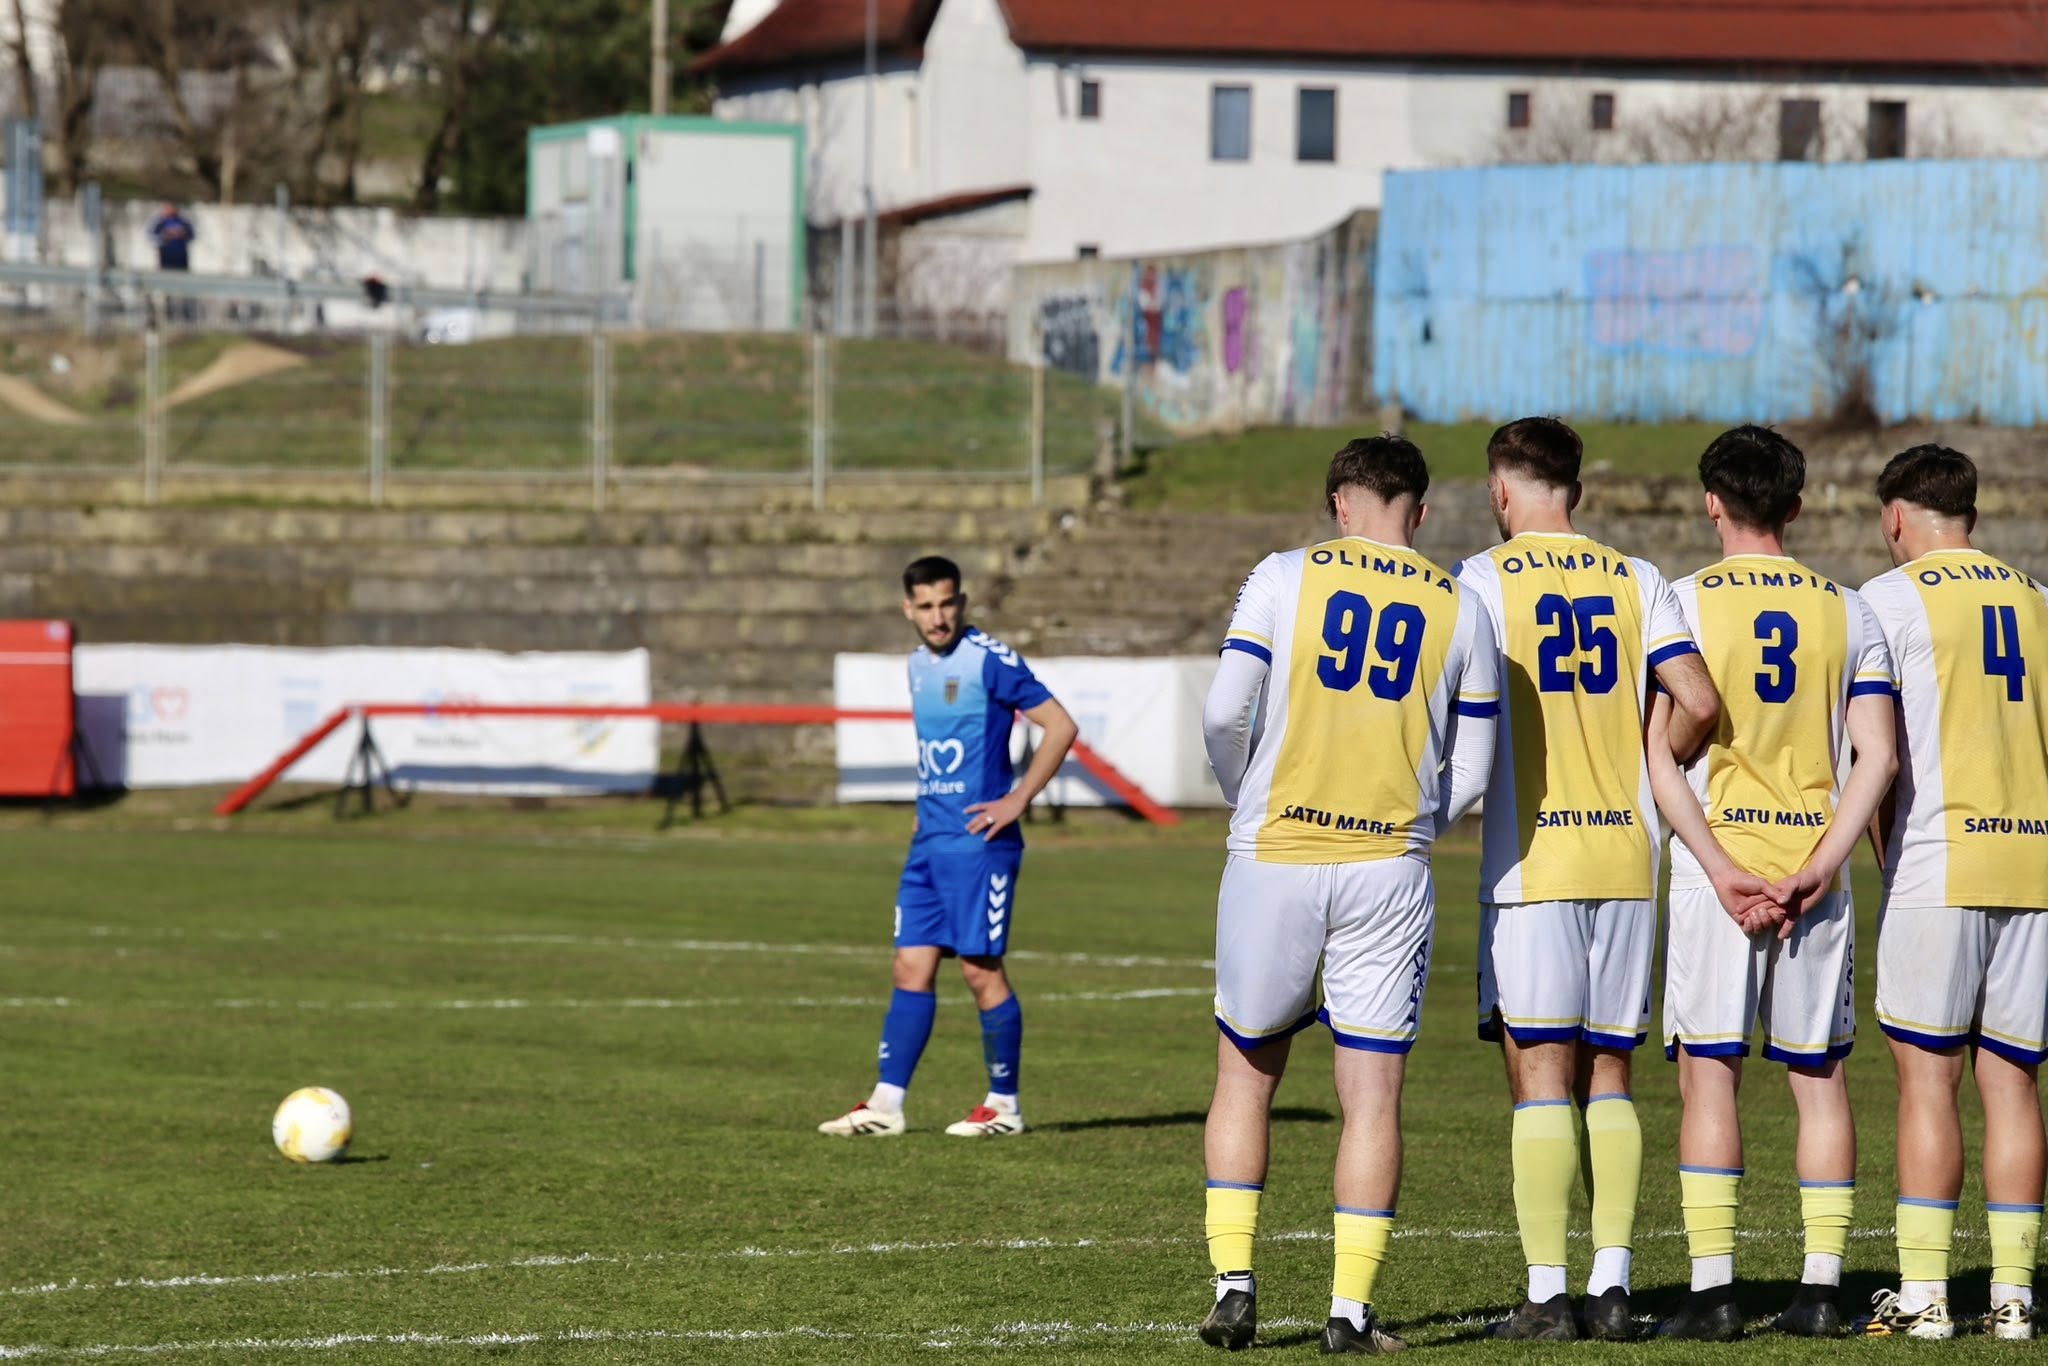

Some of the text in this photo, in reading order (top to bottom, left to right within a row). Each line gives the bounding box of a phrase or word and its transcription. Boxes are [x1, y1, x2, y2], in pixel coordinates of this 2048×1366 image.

[1312, 550, 1453, 594] OLIMPIA
[1503, 551, 1628, 577] OLIMPIA
[1703, 573, 1838, 596] OLIMPIA
[1919, 565, 2038, 592] OLIMPIA
[1316, 590, 1427, 702] 99
[1535, 593, 1618, 695] 25
[1754, 610, 1799, 704] 3
[1983, 605, 2026, 702] 4
[1280, 805, 1396, 835] SATU MARE
[1537, 809, 1632, 828] SATU MARE
[1723, 808, 1825, 827] SATU MARE
[1965, 817, 2048, 835] SATU MA
